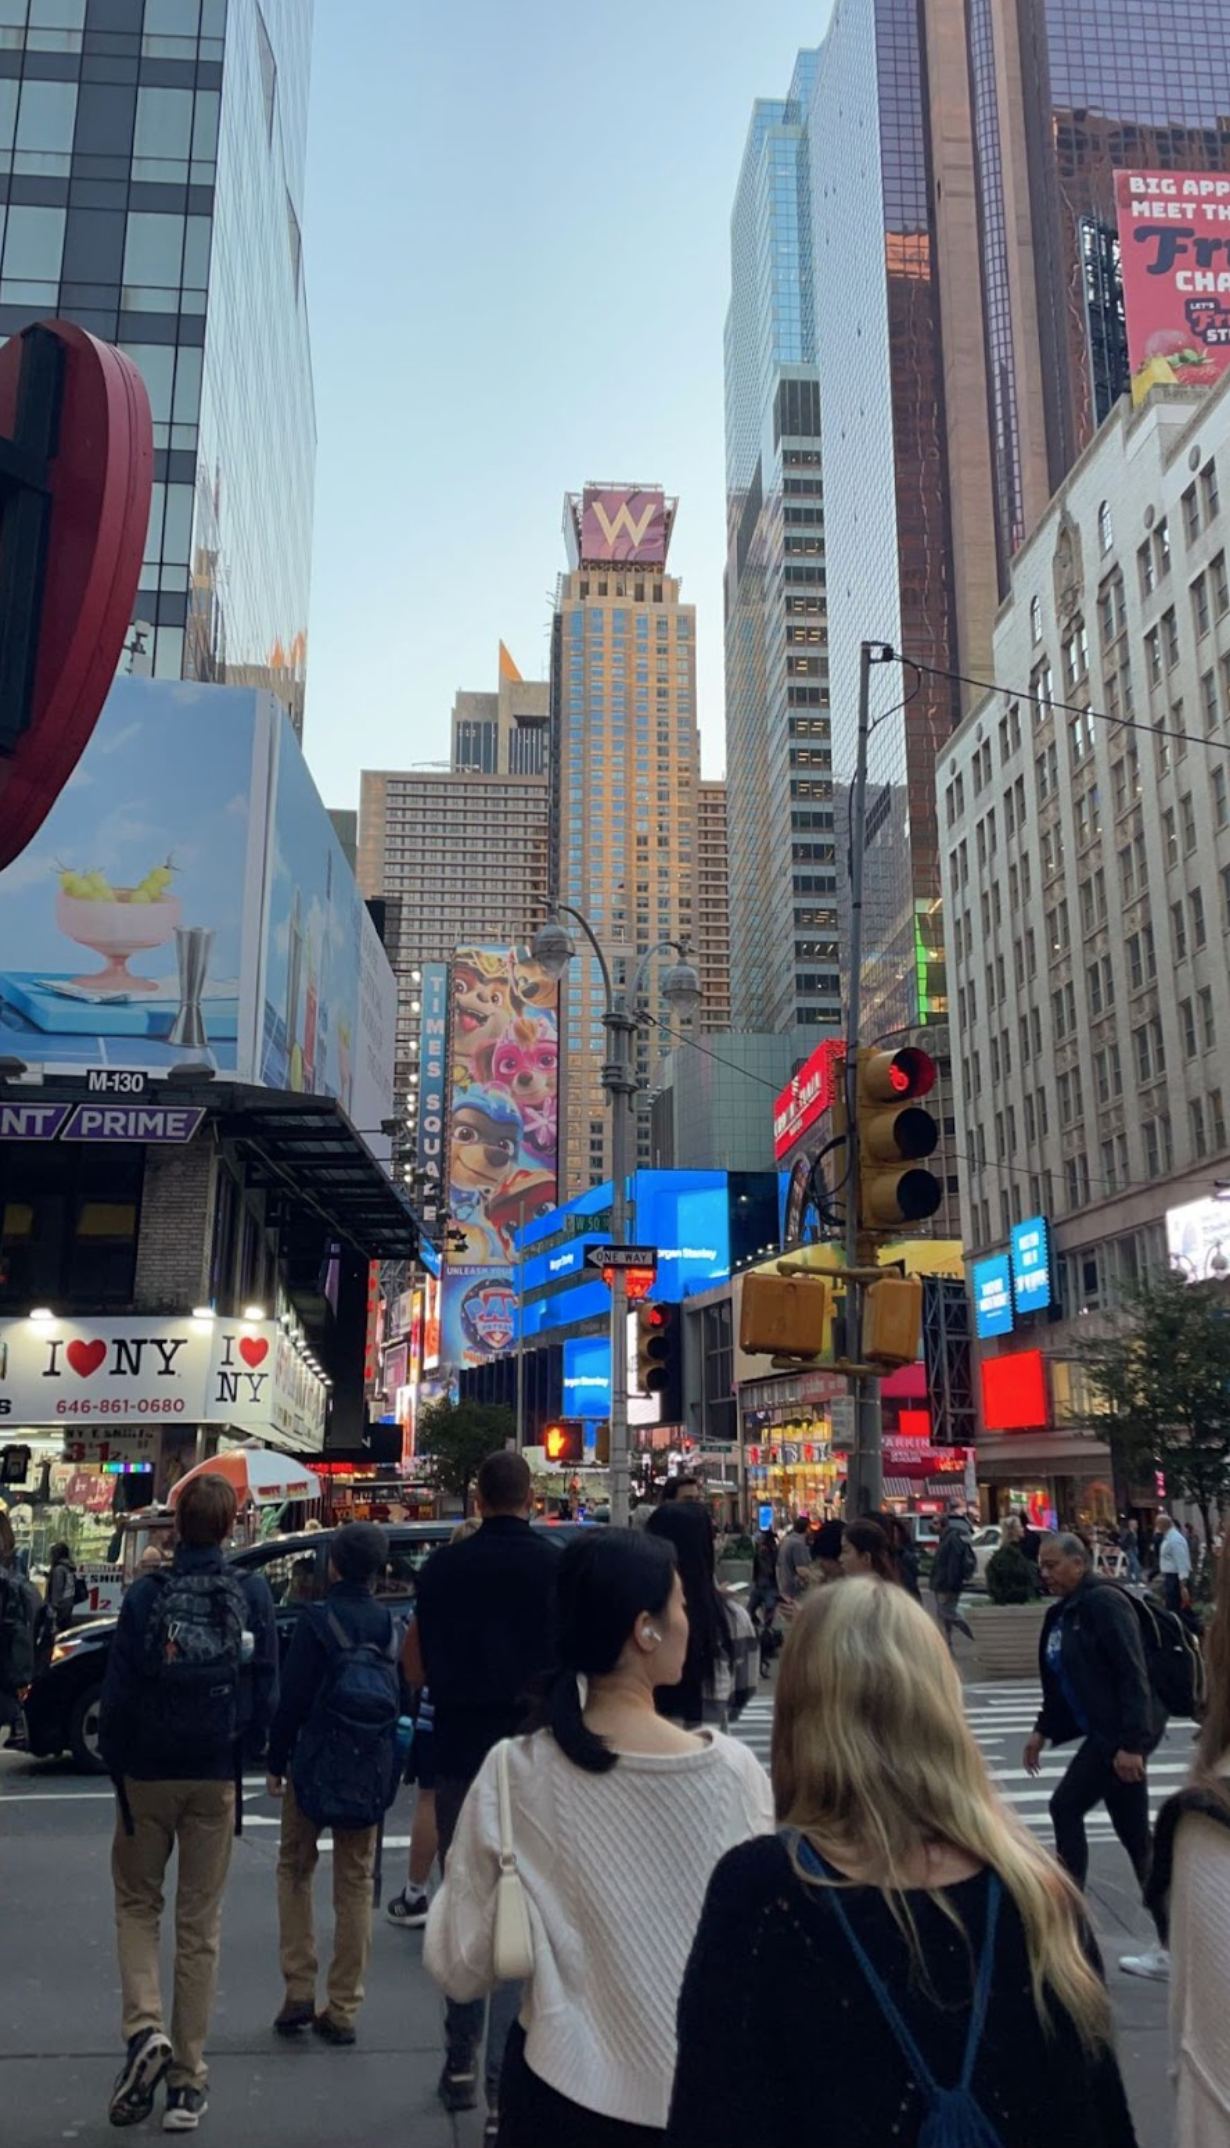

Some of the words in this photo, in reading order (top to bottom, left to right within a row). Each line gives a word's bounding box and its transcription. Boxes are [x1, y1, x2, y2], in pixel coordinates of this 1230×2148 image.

[1130, 177, 1177, 194] BIG
[1183, 179, 1230, 196] APP
[1131, 201, 1196, 219] MEET
[1133, 225, 1230, 275] Fr
[1190, 302, 1215, 310] LET'S
[1206, 329, 1230, 342] ST
[592, 502, 655, 548] W
[425, 976, 444, 1078] TIMES
[88, 1072, 143, 1092] M-130
[1, 1109, 55, 1135] NT
[80, 1111, 187, 1137] PRIME
[576, 1217, 585, 1231] W
[588, 1217, 600, 1231] 50
[597, 1252, 618, 1262] ONE
[625, 1252, 647, 1262] WAY
[657, 1249, 682, 1260] organ
[446, 1267, 488, 1276] UNLEASH
[43, 1340, 64, 1377] I
[109, 1339, 187, 1375] NY
[220, 1335, 236, 1365] I
[215, 1371, 269, 1403] NY
[56, 1399, 185, 1415] 646-861-0680
[881, 1437, 929, 1448] ARKIN
